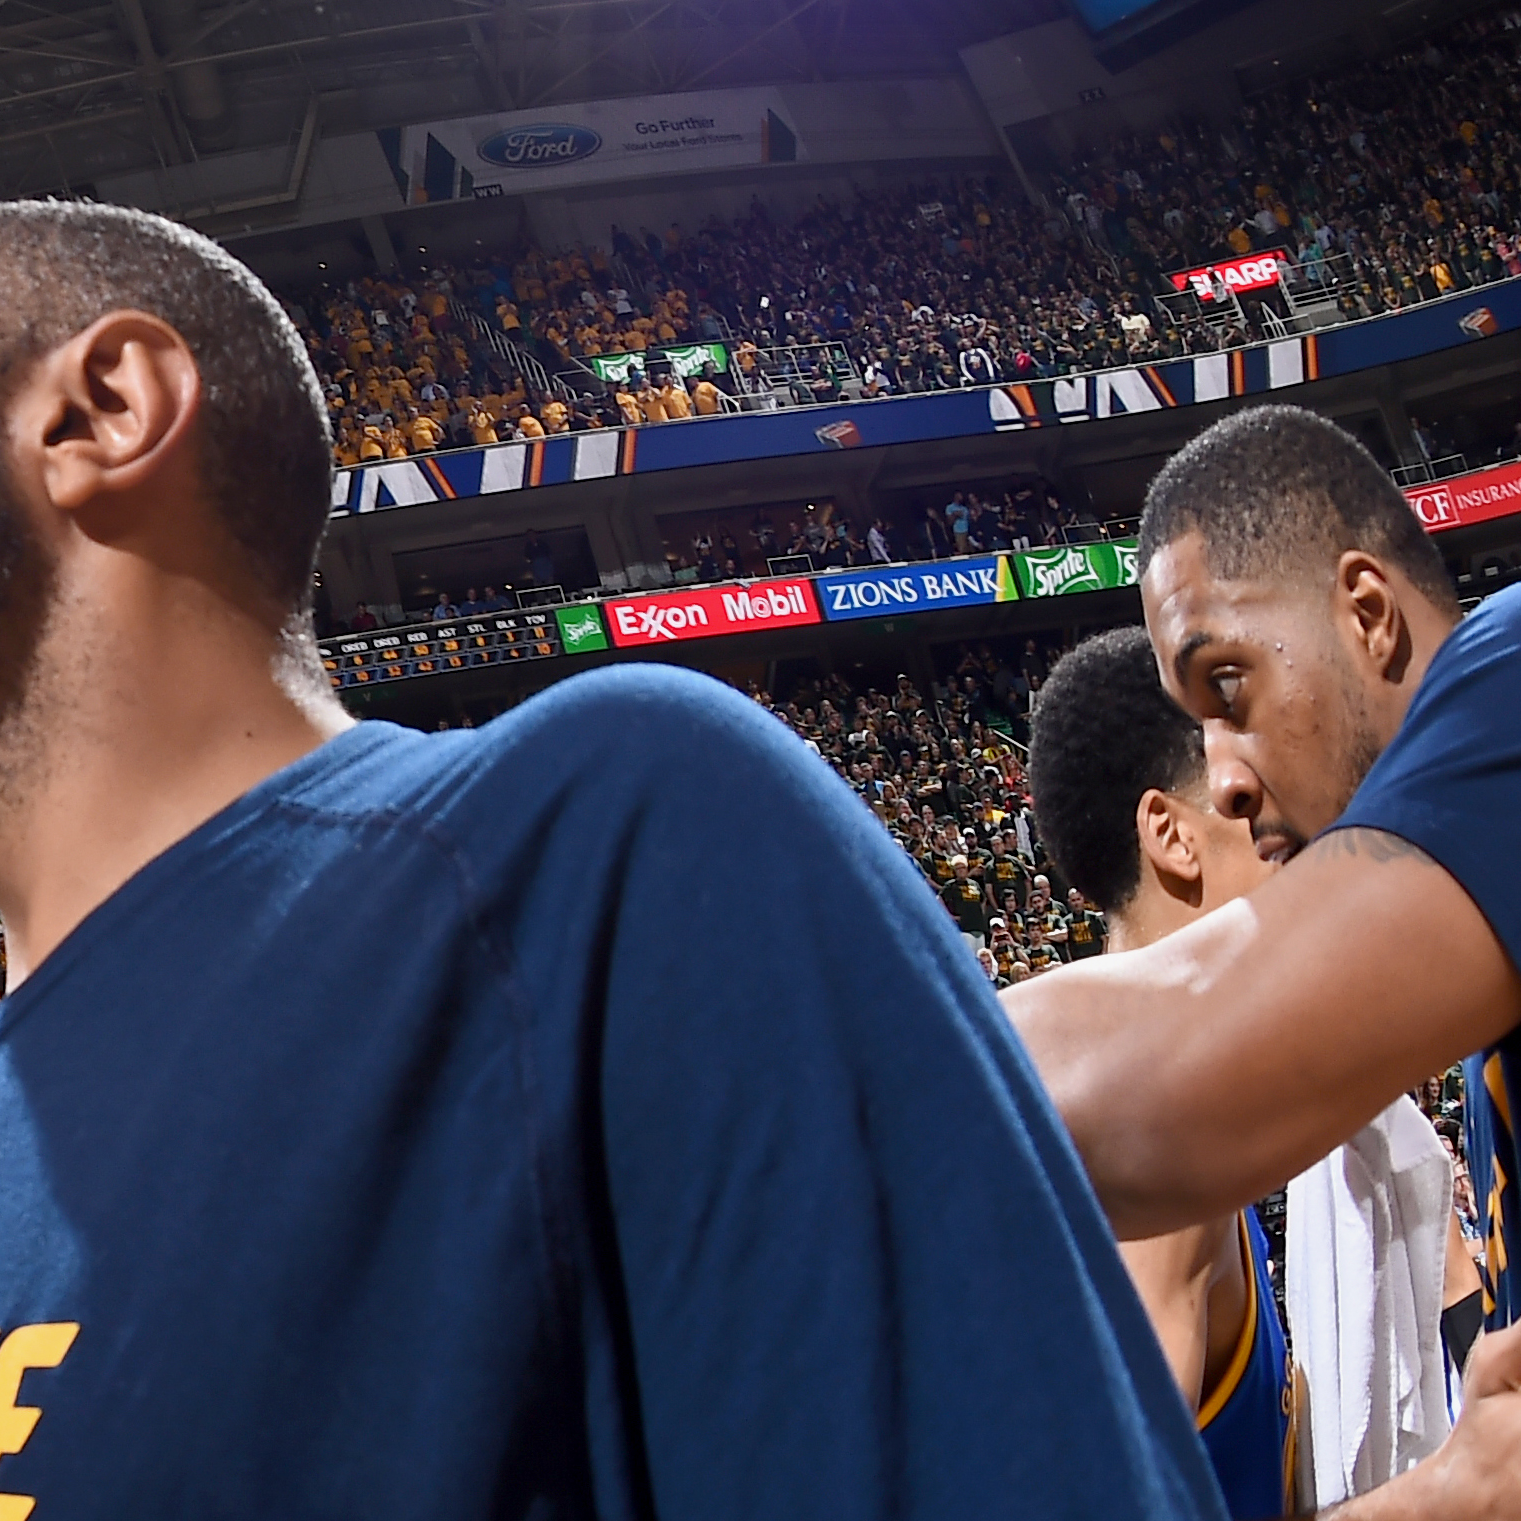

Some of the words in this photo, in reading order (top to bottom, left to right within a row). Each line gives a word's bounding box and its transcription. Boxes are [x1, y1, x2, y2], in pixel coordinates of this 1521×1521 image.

[635, 120, 659, 135] Go
[660, 116, 716, 133] Further
[505, 129, 577, 163] Ford
[1189, 258, 1278, 296] SHARP
[826, 577, 917, 611] ZIONS
[926, 570, 999, 600] BANK
[1035, 551, 1086, 592] Sprite
[438, 627, 457, 638] AST
[467, 623, 487, 633] STL
[495, 619, 517, 629] BLK
[615, 601, 708, 637] Exxon
[720, 586, 807, 622] Mobil
